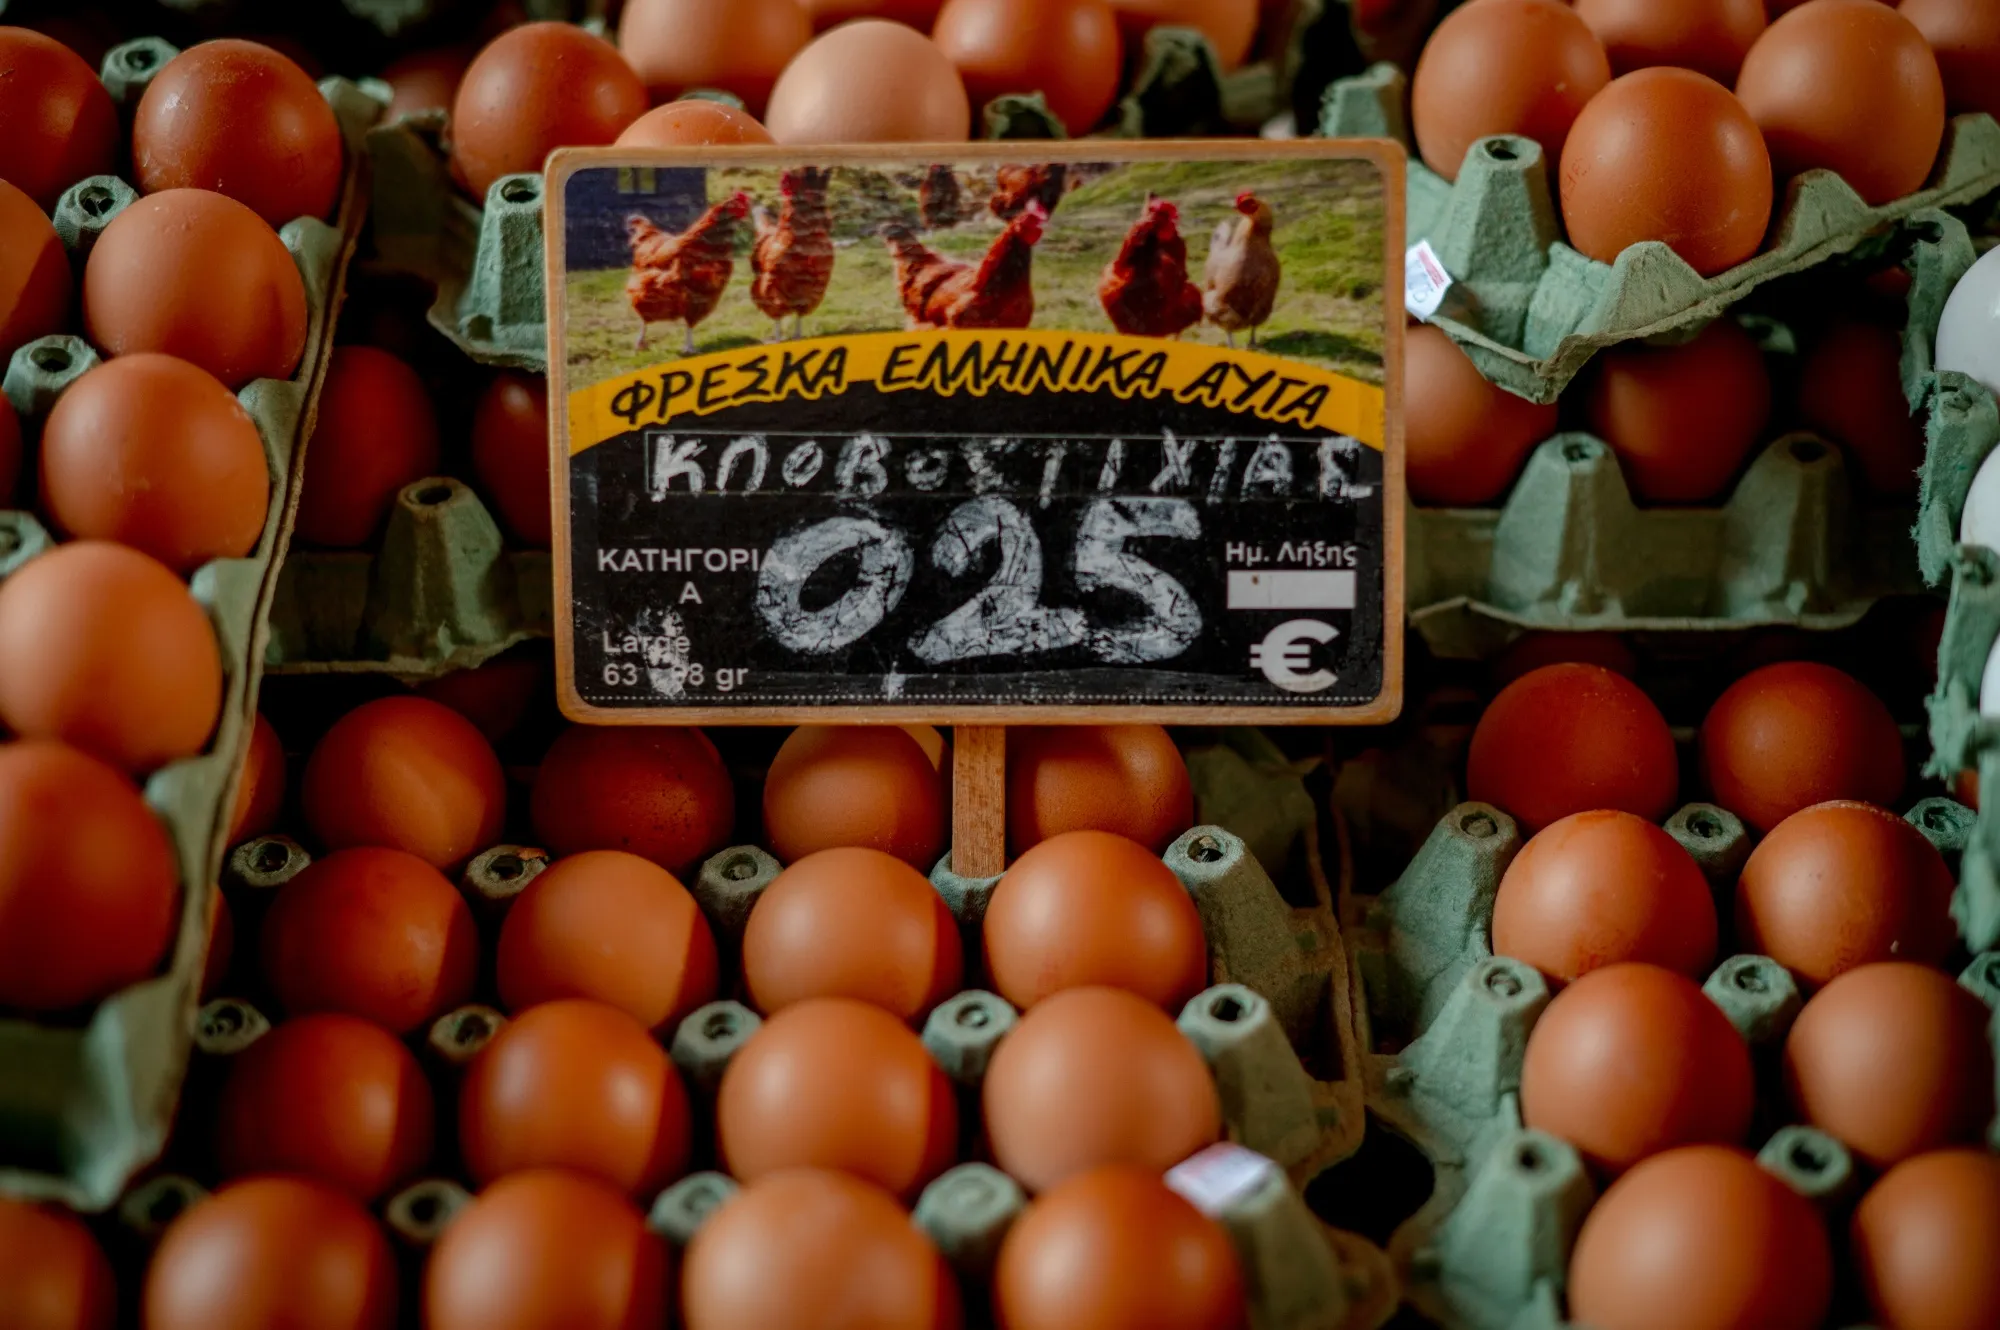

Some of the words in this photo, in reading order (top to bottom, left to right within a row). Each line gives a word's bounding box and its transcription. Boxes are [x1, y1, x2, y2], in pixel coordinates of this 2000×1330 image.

[609, 346, 848, 425] ΦΡΕΣΚΑ
[881, 339, 1168, 392] ΕΛΛΗΝΙΚΑ
[1182, 360, 1331, 423] ΑΥΓΑ
[1277, 541, 1358, 567] Λήξης
[604, 663, 638, 685] 63
[716, 667, 749, 691] gr
